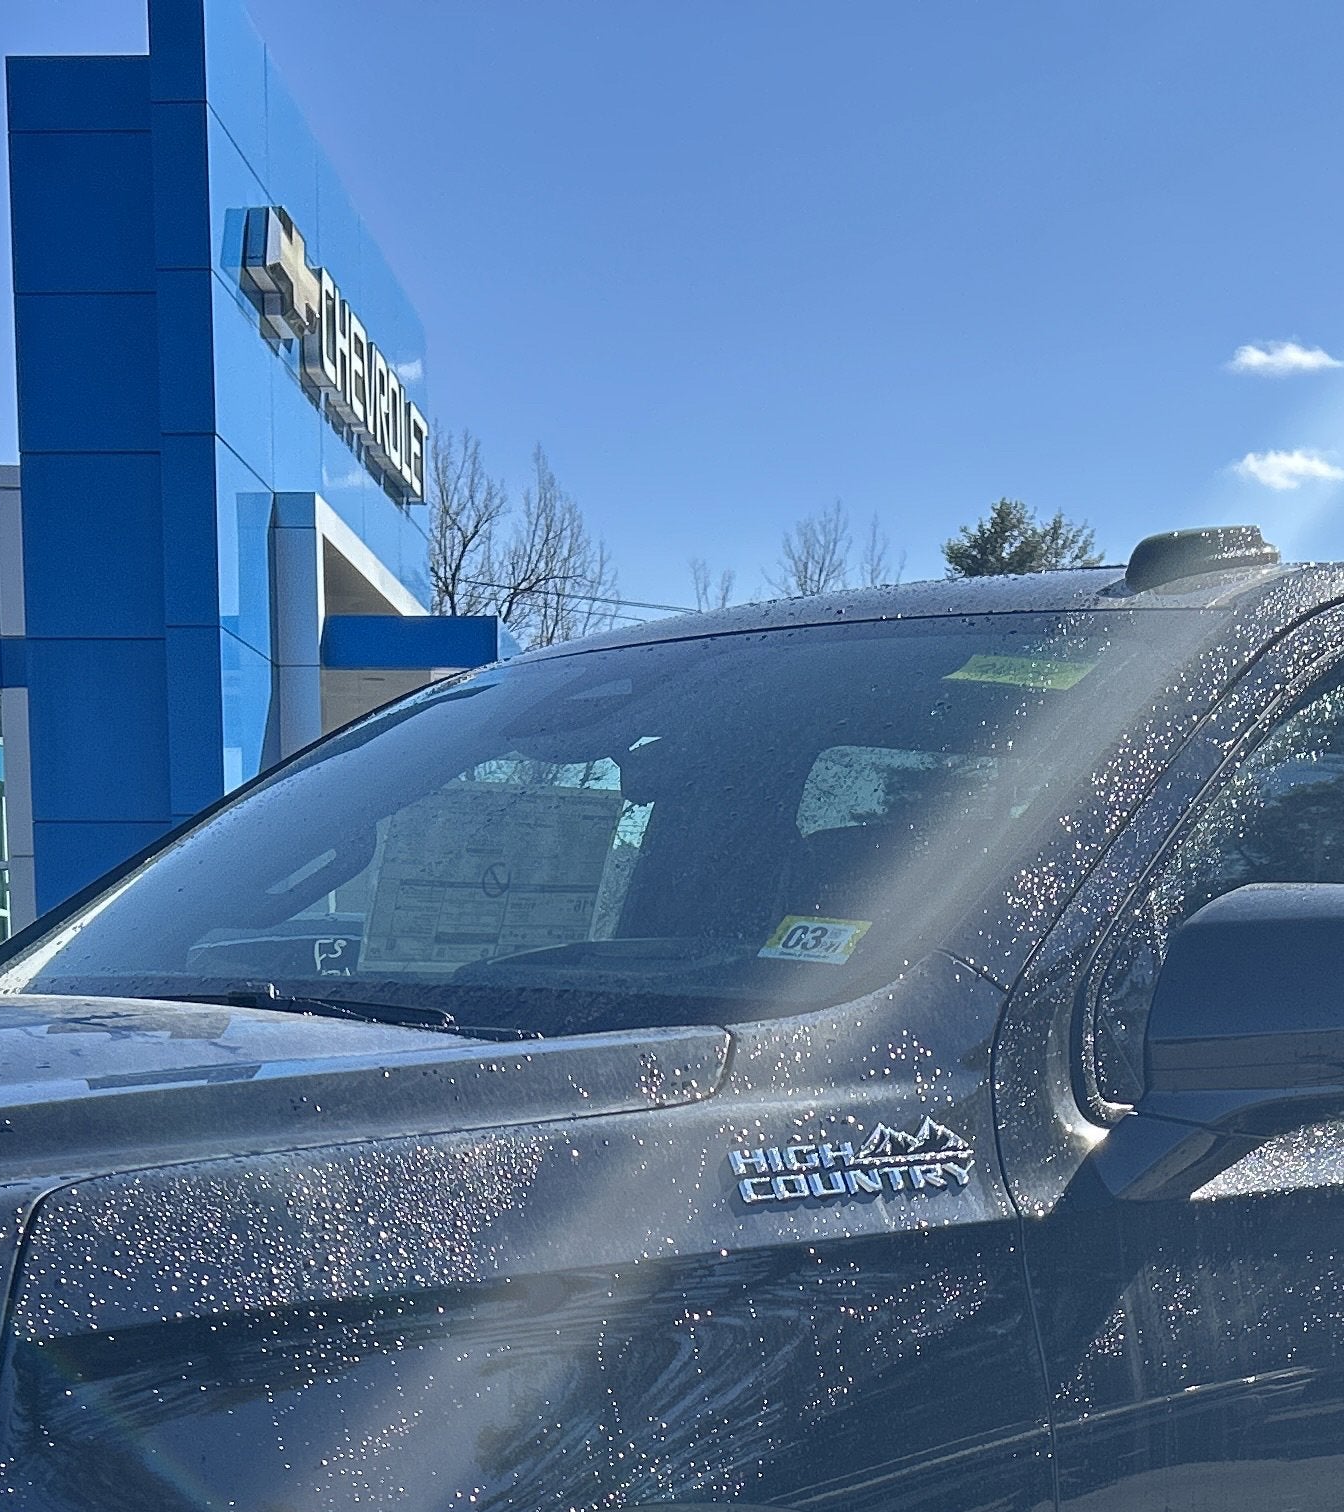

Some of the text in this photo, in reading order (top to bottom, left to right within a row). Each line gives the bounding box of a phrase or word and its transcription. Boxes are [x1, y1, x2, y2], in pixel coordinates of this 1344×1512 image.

[319, 266, 430, 505] CHEVROLET
[781, 925, 828, 951] 03
[727, 1141, 855, 1175] HIGH
[738, 1160, 975, 1203] COUNTRY
